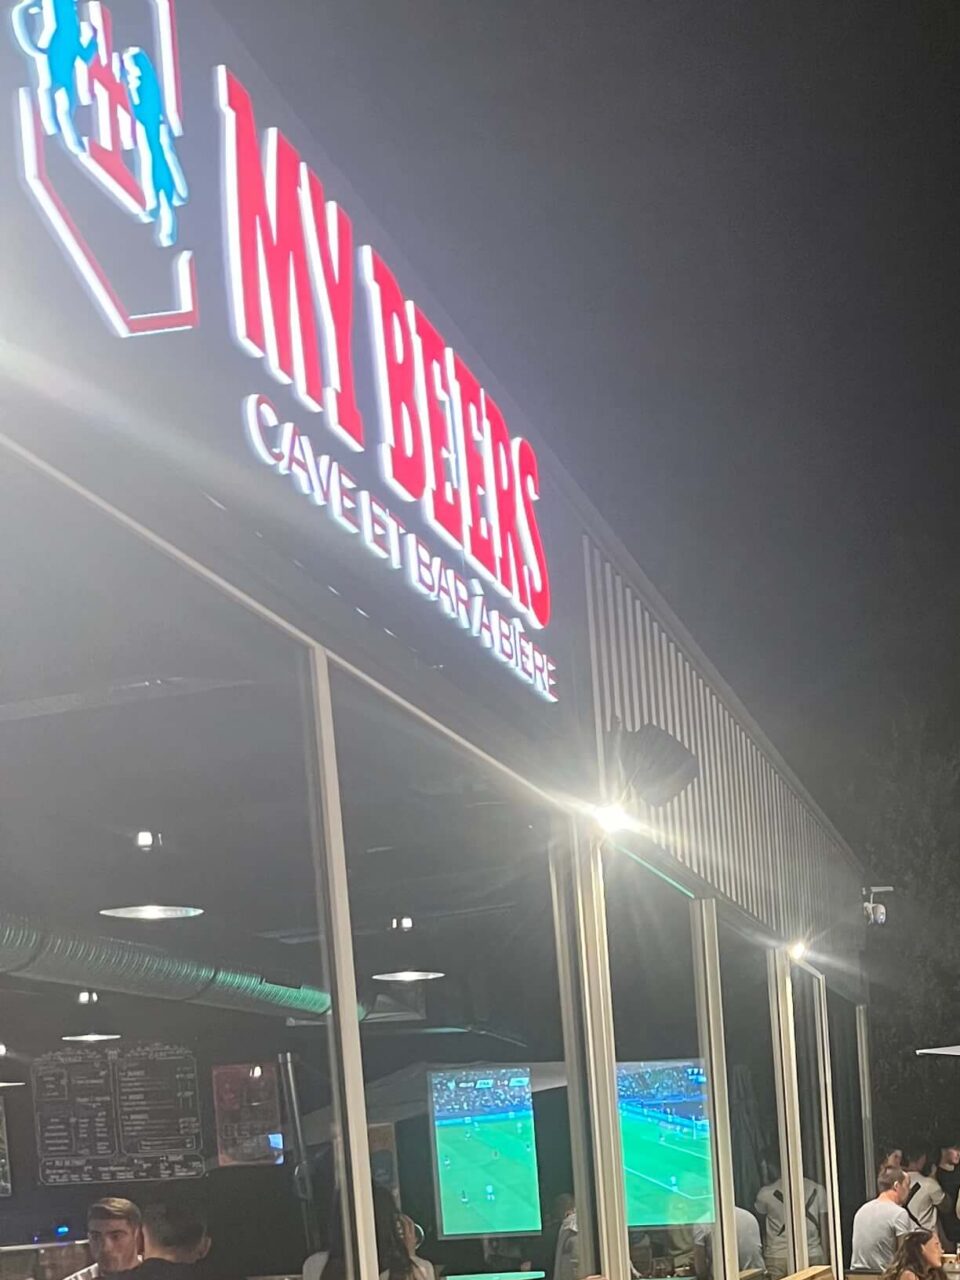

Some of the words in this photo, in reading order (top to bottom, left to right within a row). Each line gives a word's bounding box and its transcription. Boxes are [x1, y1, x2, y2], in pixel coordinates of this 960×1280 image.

[216, 64, 364, 452] MY
[358, 244, 551, 630] BEERS
[244, 393, 360, 533] CAVE
[360, 489, 406, 569] ET
[404, 532, 471, 629] BAR
